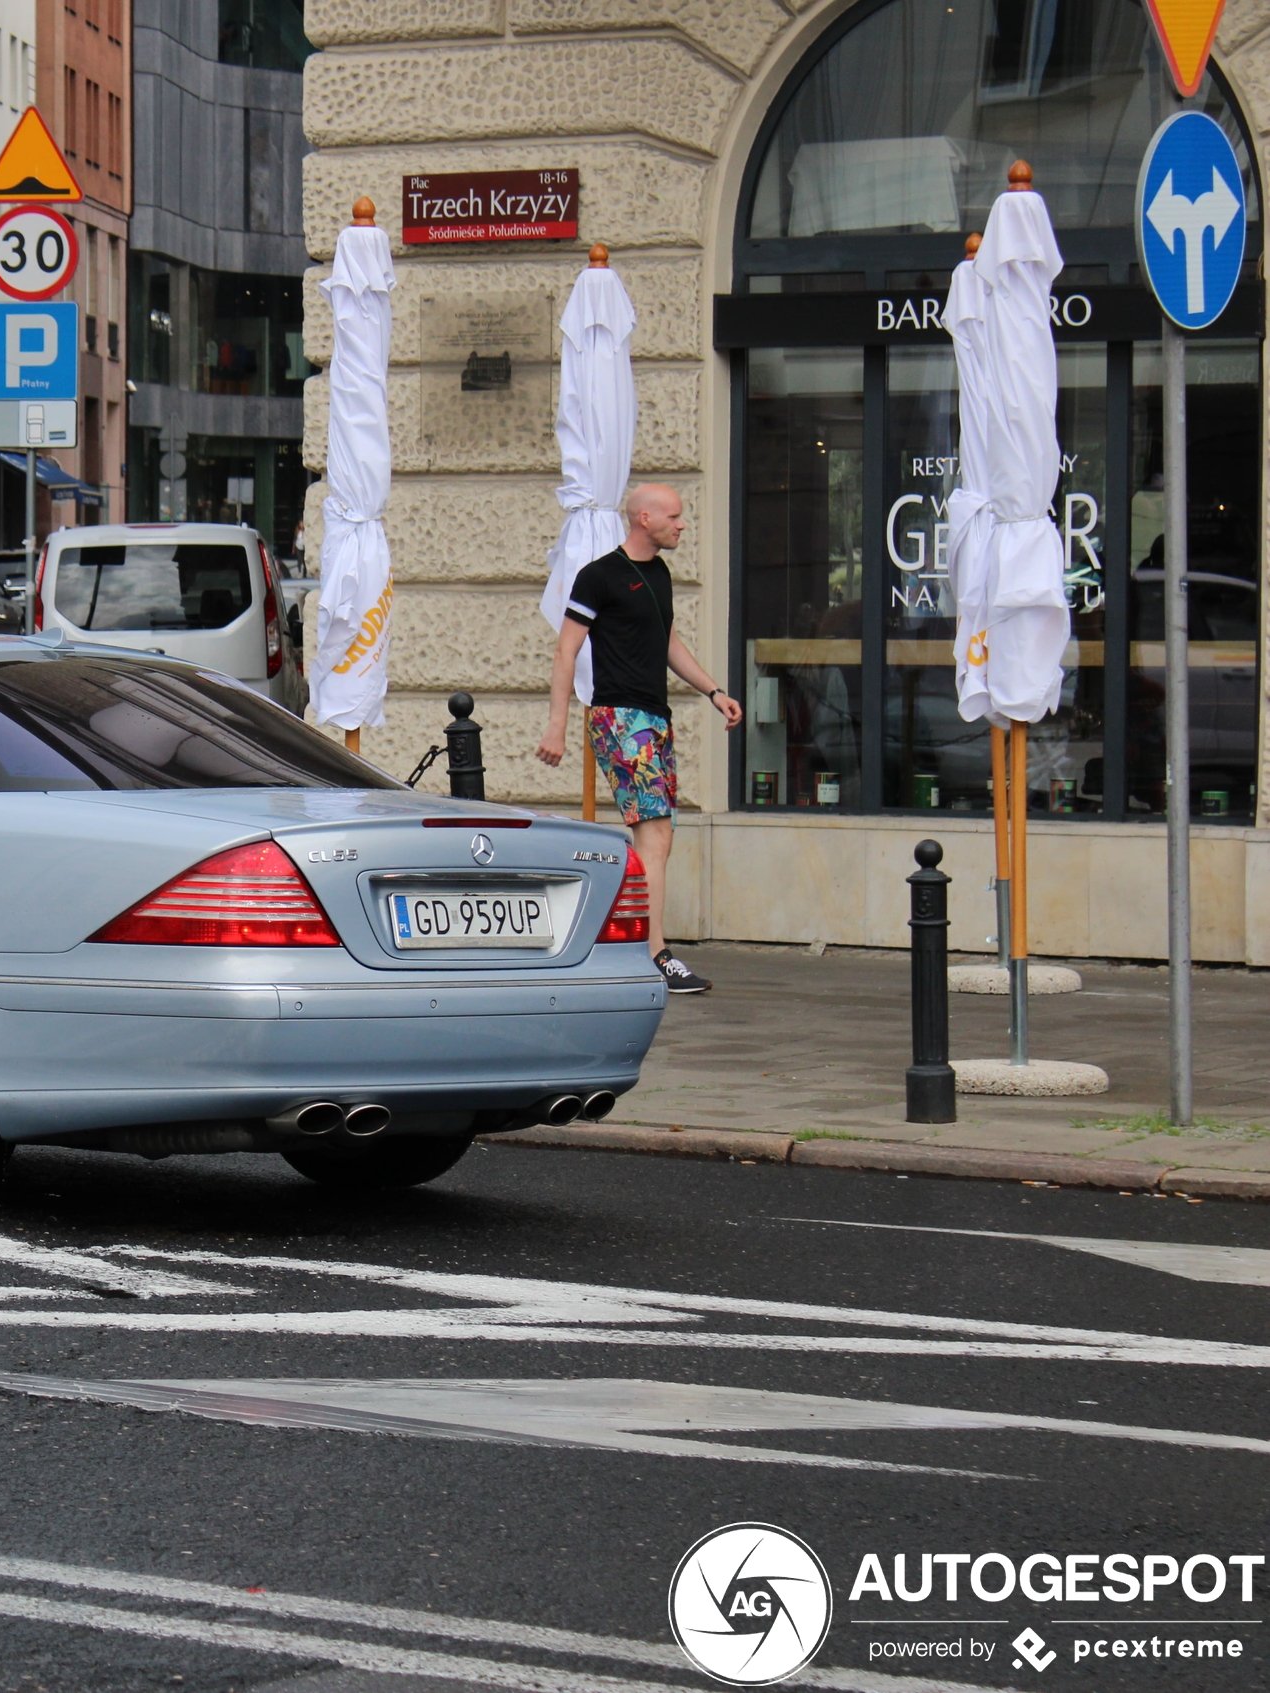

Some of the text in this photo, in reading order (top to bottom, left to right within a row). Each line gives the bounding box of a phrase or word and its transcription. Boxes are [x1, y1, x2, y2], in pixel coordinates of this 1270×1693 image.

[411, 177, 429, 190] Plac
[538, 172, 568, 184] 18-16
[408, 187, 571, 223] Trzech Krzyży
[428, 223, 547, 240] Śródmieście Południowe
[0, 230, 64, 273] 30
[877, 298, 943, 330] BAR
[6, 313, 58, 388] P
[21, 379, 50, 389] Płatny
[399, 922, 410, 934] PL
[414, 900, 541, 935] GD 959UP
